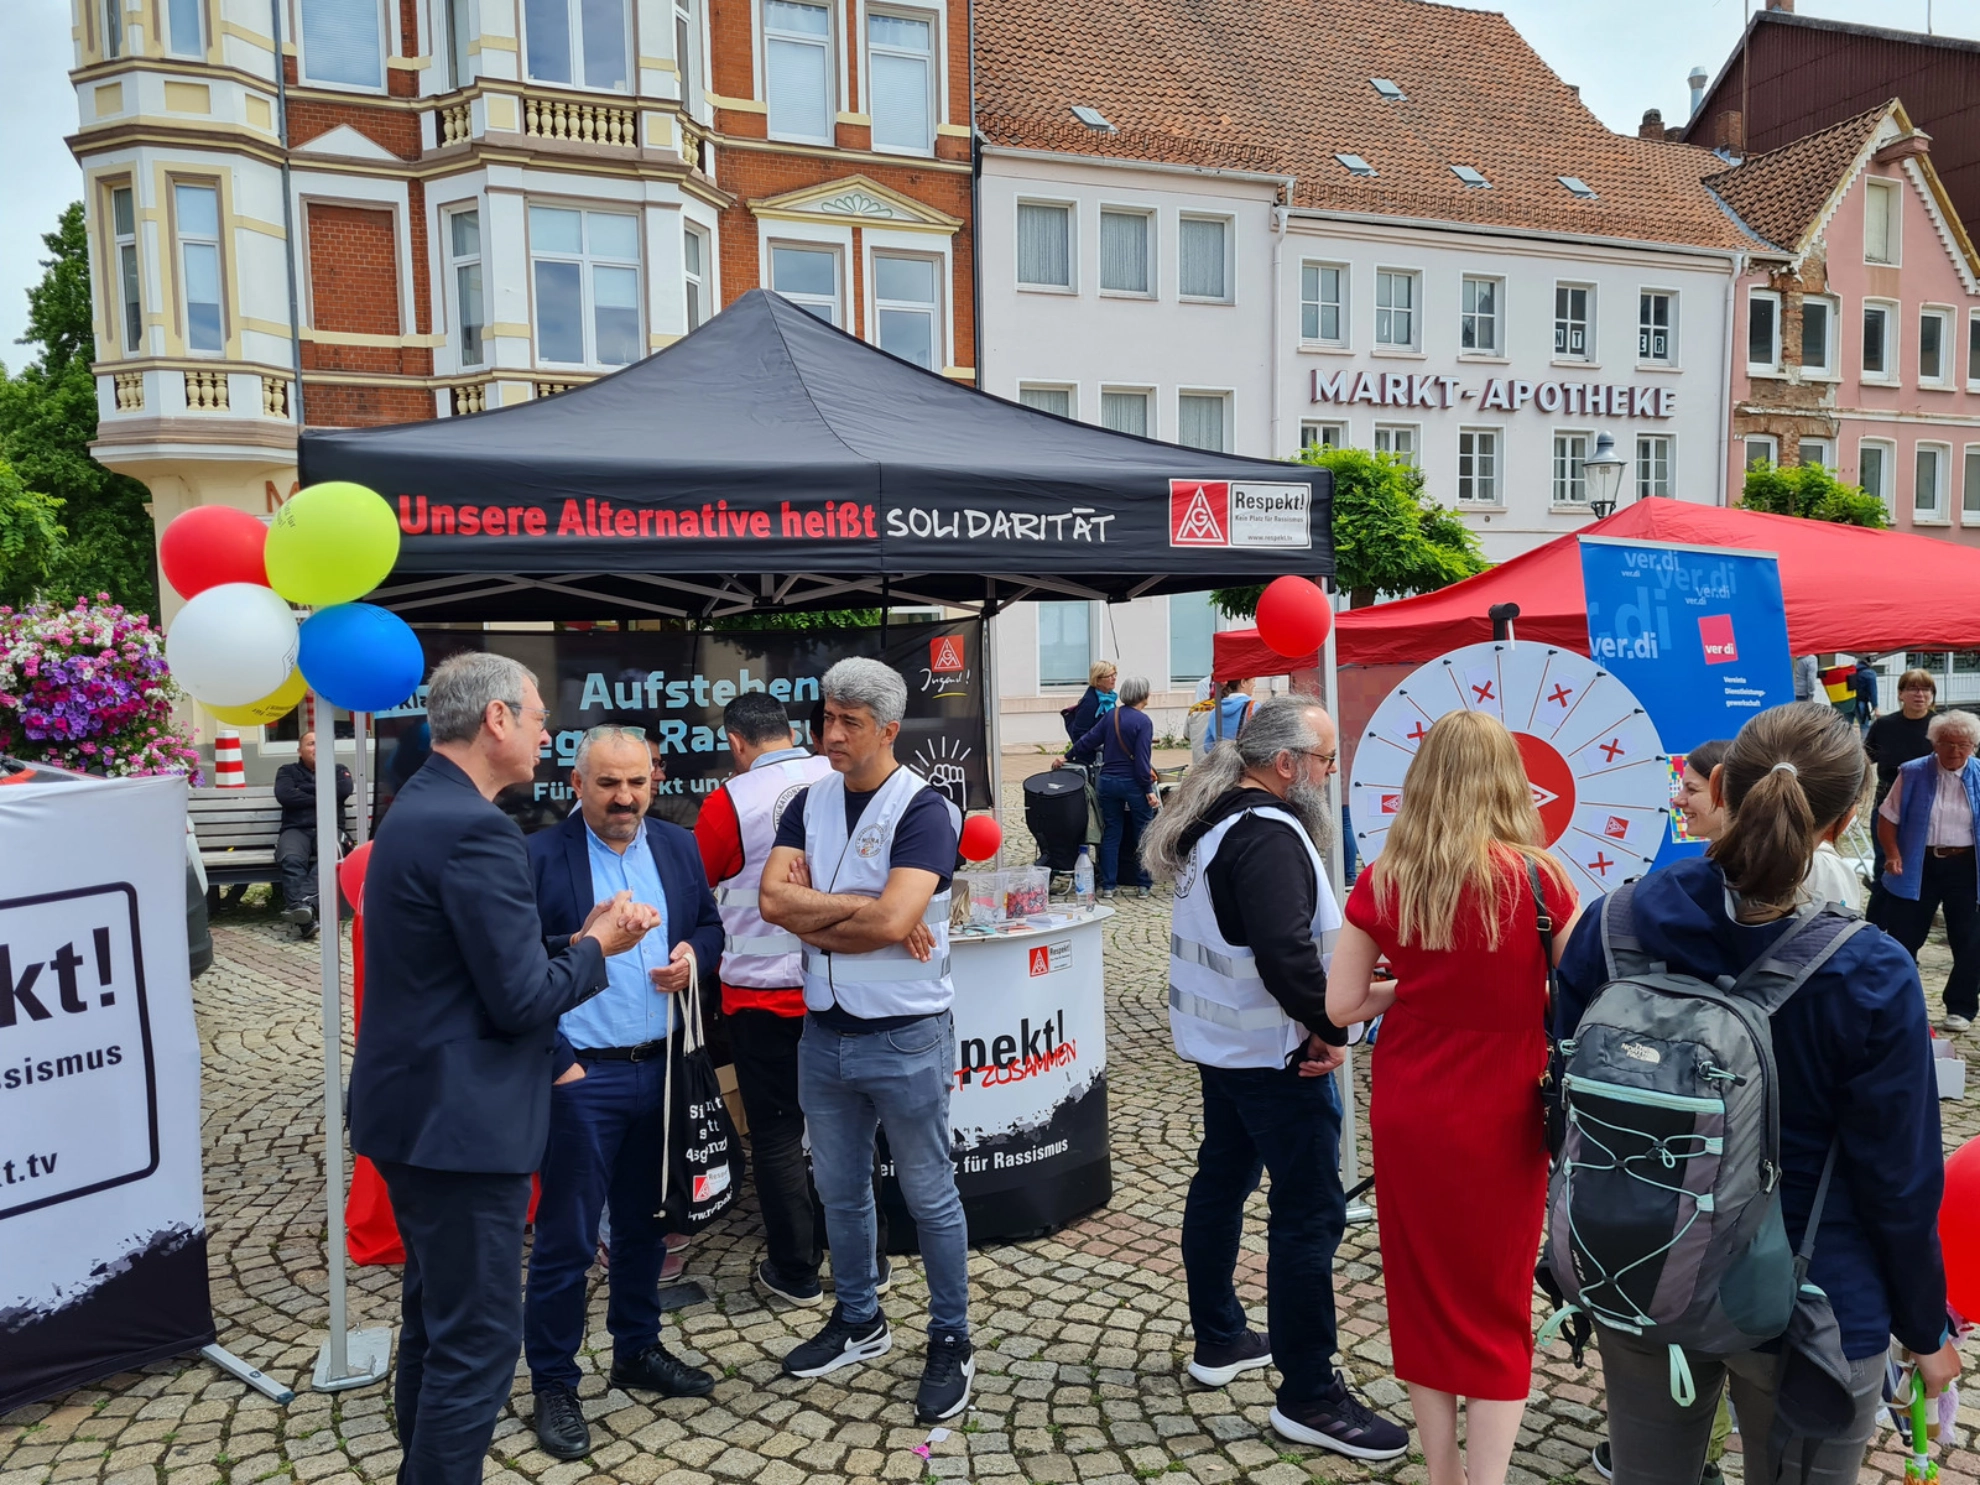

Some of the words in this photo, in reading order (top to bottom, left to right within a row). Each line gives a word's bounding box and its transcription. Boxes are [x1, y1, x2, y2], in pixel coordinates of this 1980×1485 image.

[399, 494, 548, 536] Unsere
[557, 497, 771, 538] Alternative
[781, 499, 878, 539] heißt
[1235, 491, 1304, 512] Respekt!
[1250, 515, 1263, 523] Platz
[1274, 515, 1304, 523] Rassismus
[1621, 570, 1641, 578] ver.di
[1624, 551, 1680, 572] ver.di
[1655, 561, 1737, 595] ver.di
[1684, 597, 1708, 606] ver.di
[1694, 585, 1731, 600] ver.di
[1588, 586, 1673, 651] r.di
[1589, 631, 1659, 660] ver.di
[579, 668, 820, 710] Aufstehen
[533, 780, 574, 802] Für
[0, 926, 116, 1029] kt!
[961, 1009, 1064, 1085] pekt!
[977, 1038, 1077, 1089] ZUSAMMEN
[0, 1044, 123, 1091] sismus
[0, 1151, 58, 1187] t.tv
[963, 1154, 989, 1175] für
[993, 1138, 1069, 1171] Rassismus
